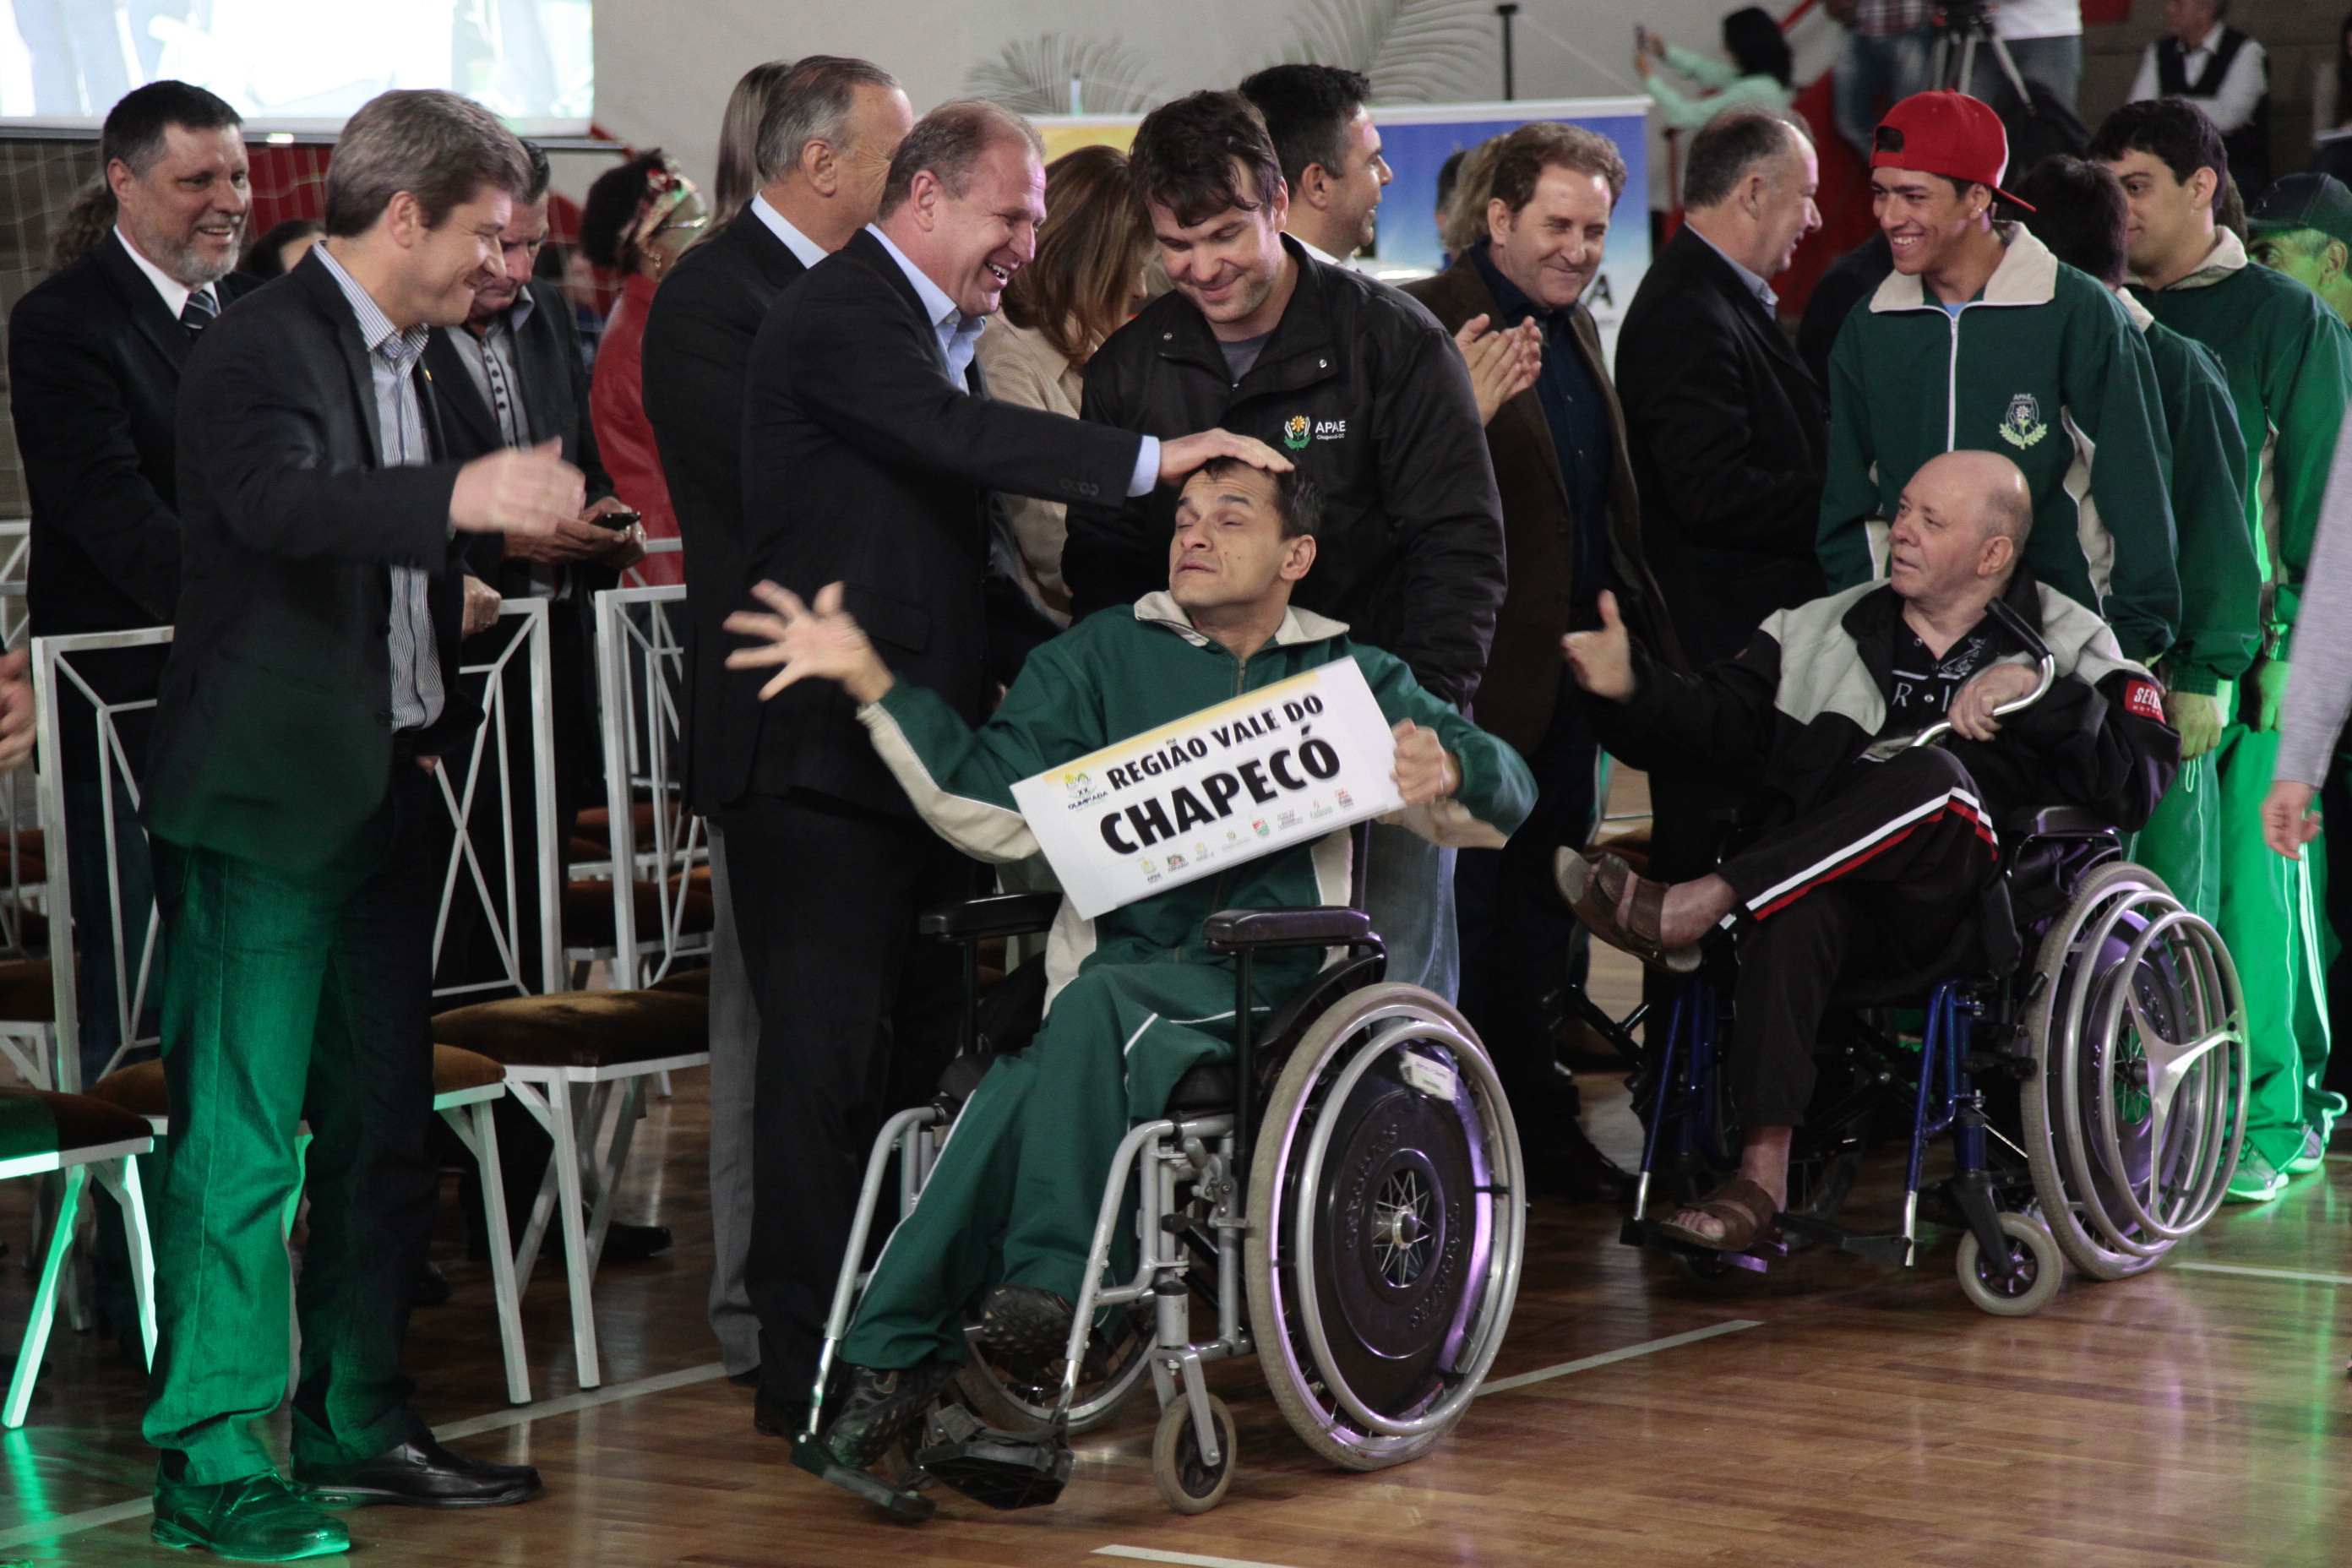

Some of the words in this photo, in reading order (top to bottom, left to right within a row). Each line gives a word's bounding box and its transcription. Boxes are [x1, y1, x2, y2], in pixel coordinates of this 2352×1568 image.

[1315, 420, 1347, 434] APAE
[1099, 722, 1341, 855] CHAPECÓ
[1106, 736, 1209, 791] REGIÃO
[1209, 708, 1282, 749] VALE
[1282, 693, 1324, 724] DO
